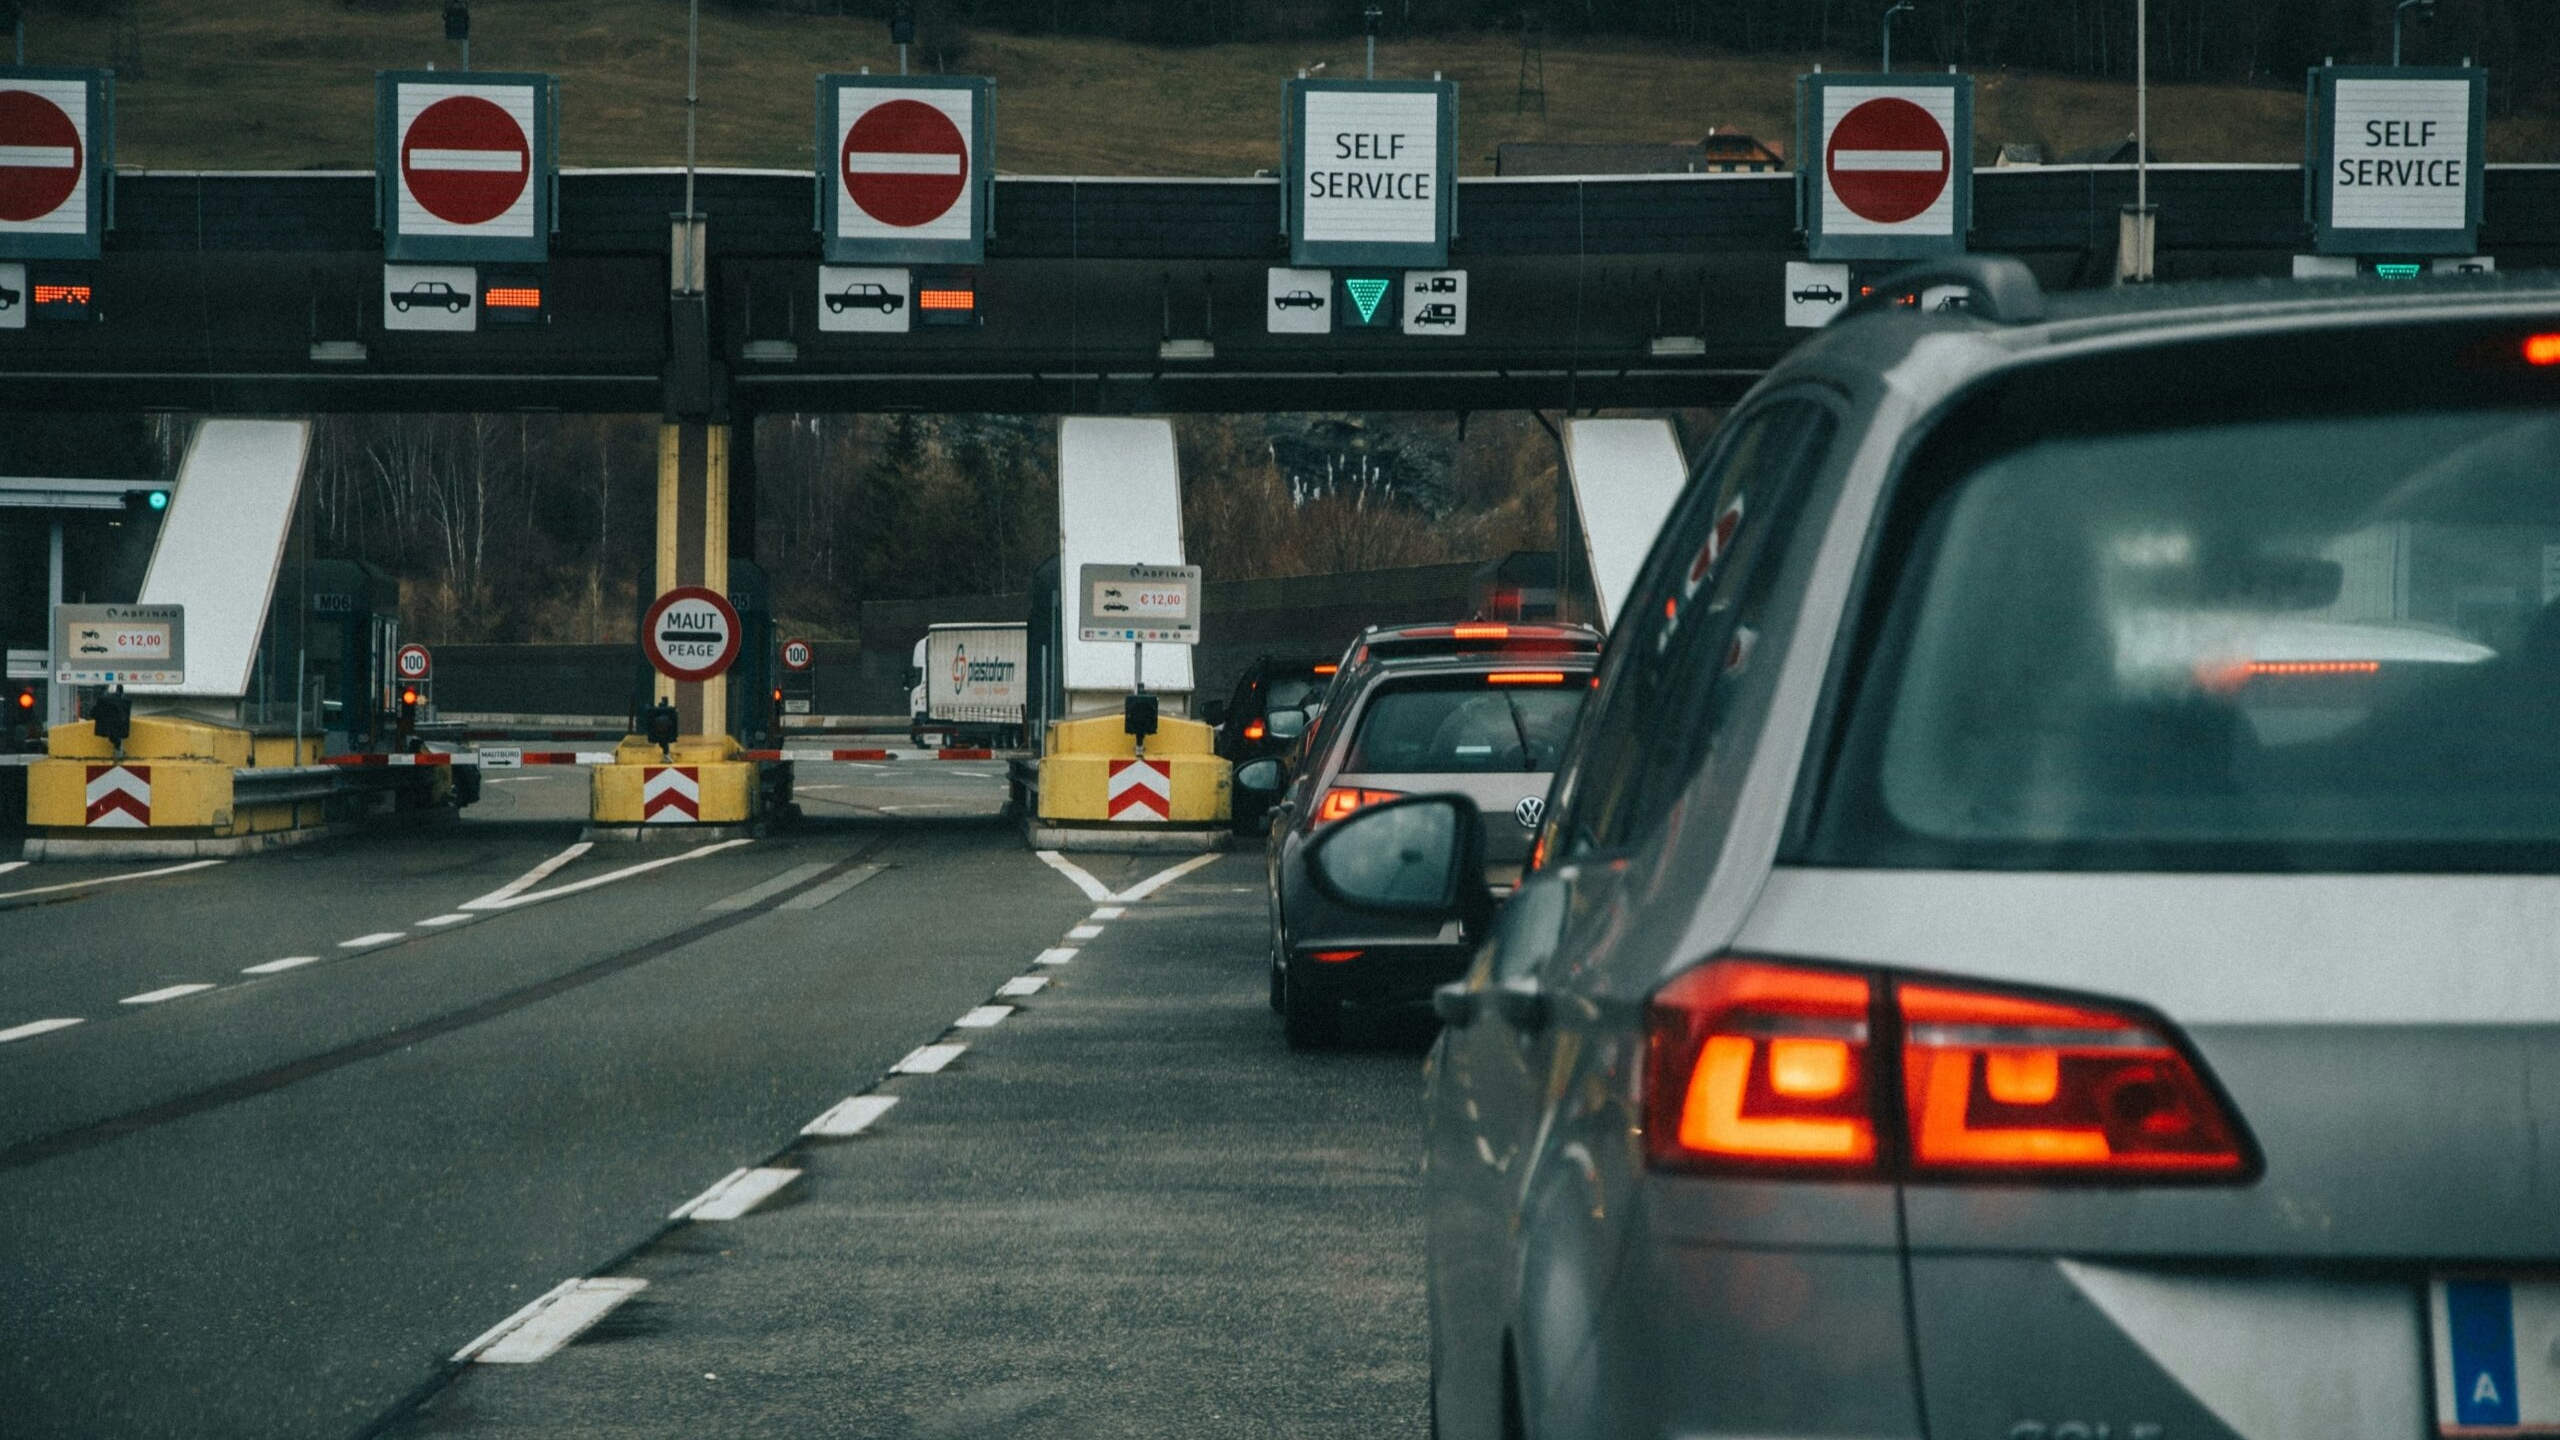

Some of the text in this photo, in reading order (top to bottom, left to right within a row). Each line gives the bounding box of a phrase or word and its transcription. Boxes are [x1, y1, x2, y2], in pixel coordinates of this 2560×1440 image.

[2365, 120, 2437, 147] SELF
[1335, 132, 1405, 159] SELF
[2338, 158, 2461, 187] SERVICE
[1309, 171, 1430, 199] SERVICE
[1142, 570, 1195, 579] ASFINAG
[319, 594, 351, 610] M06
[731, 595, 748, 607] 05
[1140, 594, 1181, 606] € 12,00
[667, 612, 717, 630] MAUT
[118, 635, 161, 647] € 12,00
[668, 643, 715, 657] PEAGE
[788, 647, 807, 662] 100
[403, 655, 424, 671] 100
[2472, 1371, 2500, 1404] A
